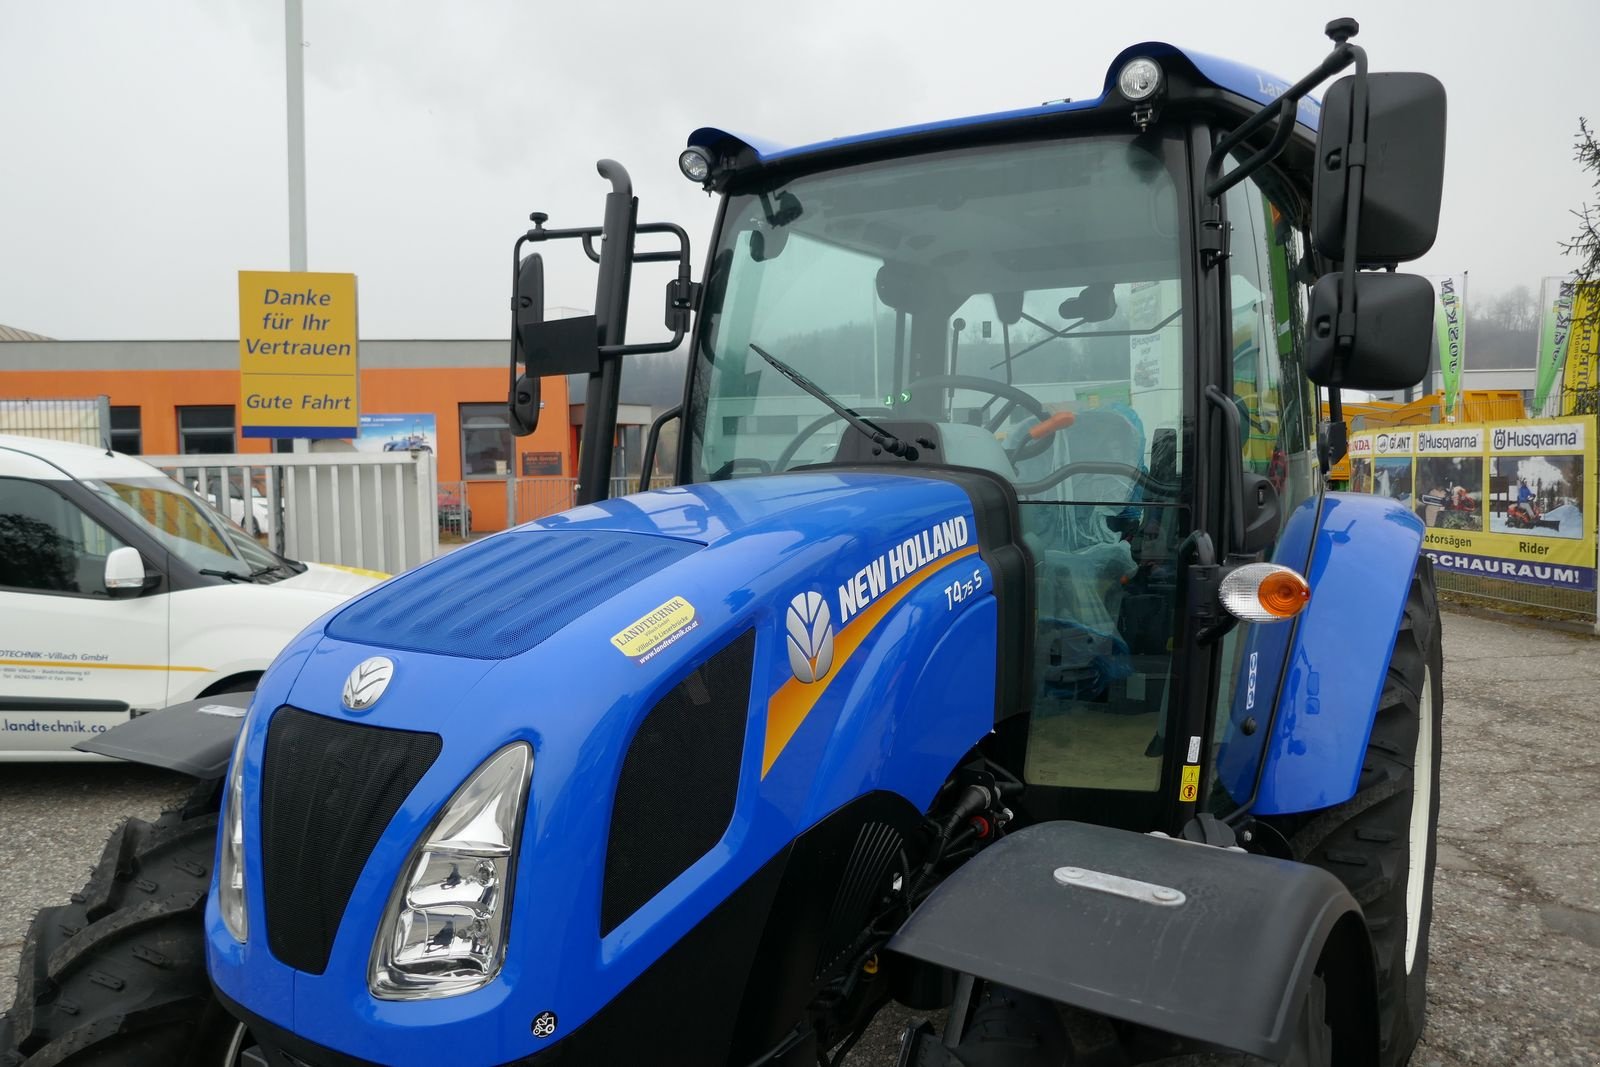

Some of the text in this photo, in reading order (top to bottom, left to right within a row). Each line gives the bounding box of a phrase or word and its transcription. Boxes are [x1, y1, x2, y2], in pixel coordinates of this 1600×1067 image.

[263, 288, 331, 306] Danke
[262, 312, 330, 331] für Ihr
[1552, 281, 1575, 361] OSKIN
[246, 338, 351, 356] Vertrauen
[246, 394, 351, 410] Gute Fahrt
[1354, 439, 1371, 451] NDA
[1425, 434, 1477, 451] Husqvarna
[1507, 431, 1577, 449] Husqvarna
[1424, 533, 1472, 548] otorsägen
[1519, 541, 1549, 555] Rider
[838, 515, 968, 624] NEW HOLLAND
[1426, 553, 1580, 583] SCHAURAUM!
[973, 569, 982, 589] S
[615, 600, 684, 646] LANDTECHNIK
[639, 620, 699, 664] www.landtechnik.co.at
[81, 653, 109, 661] GmbH
